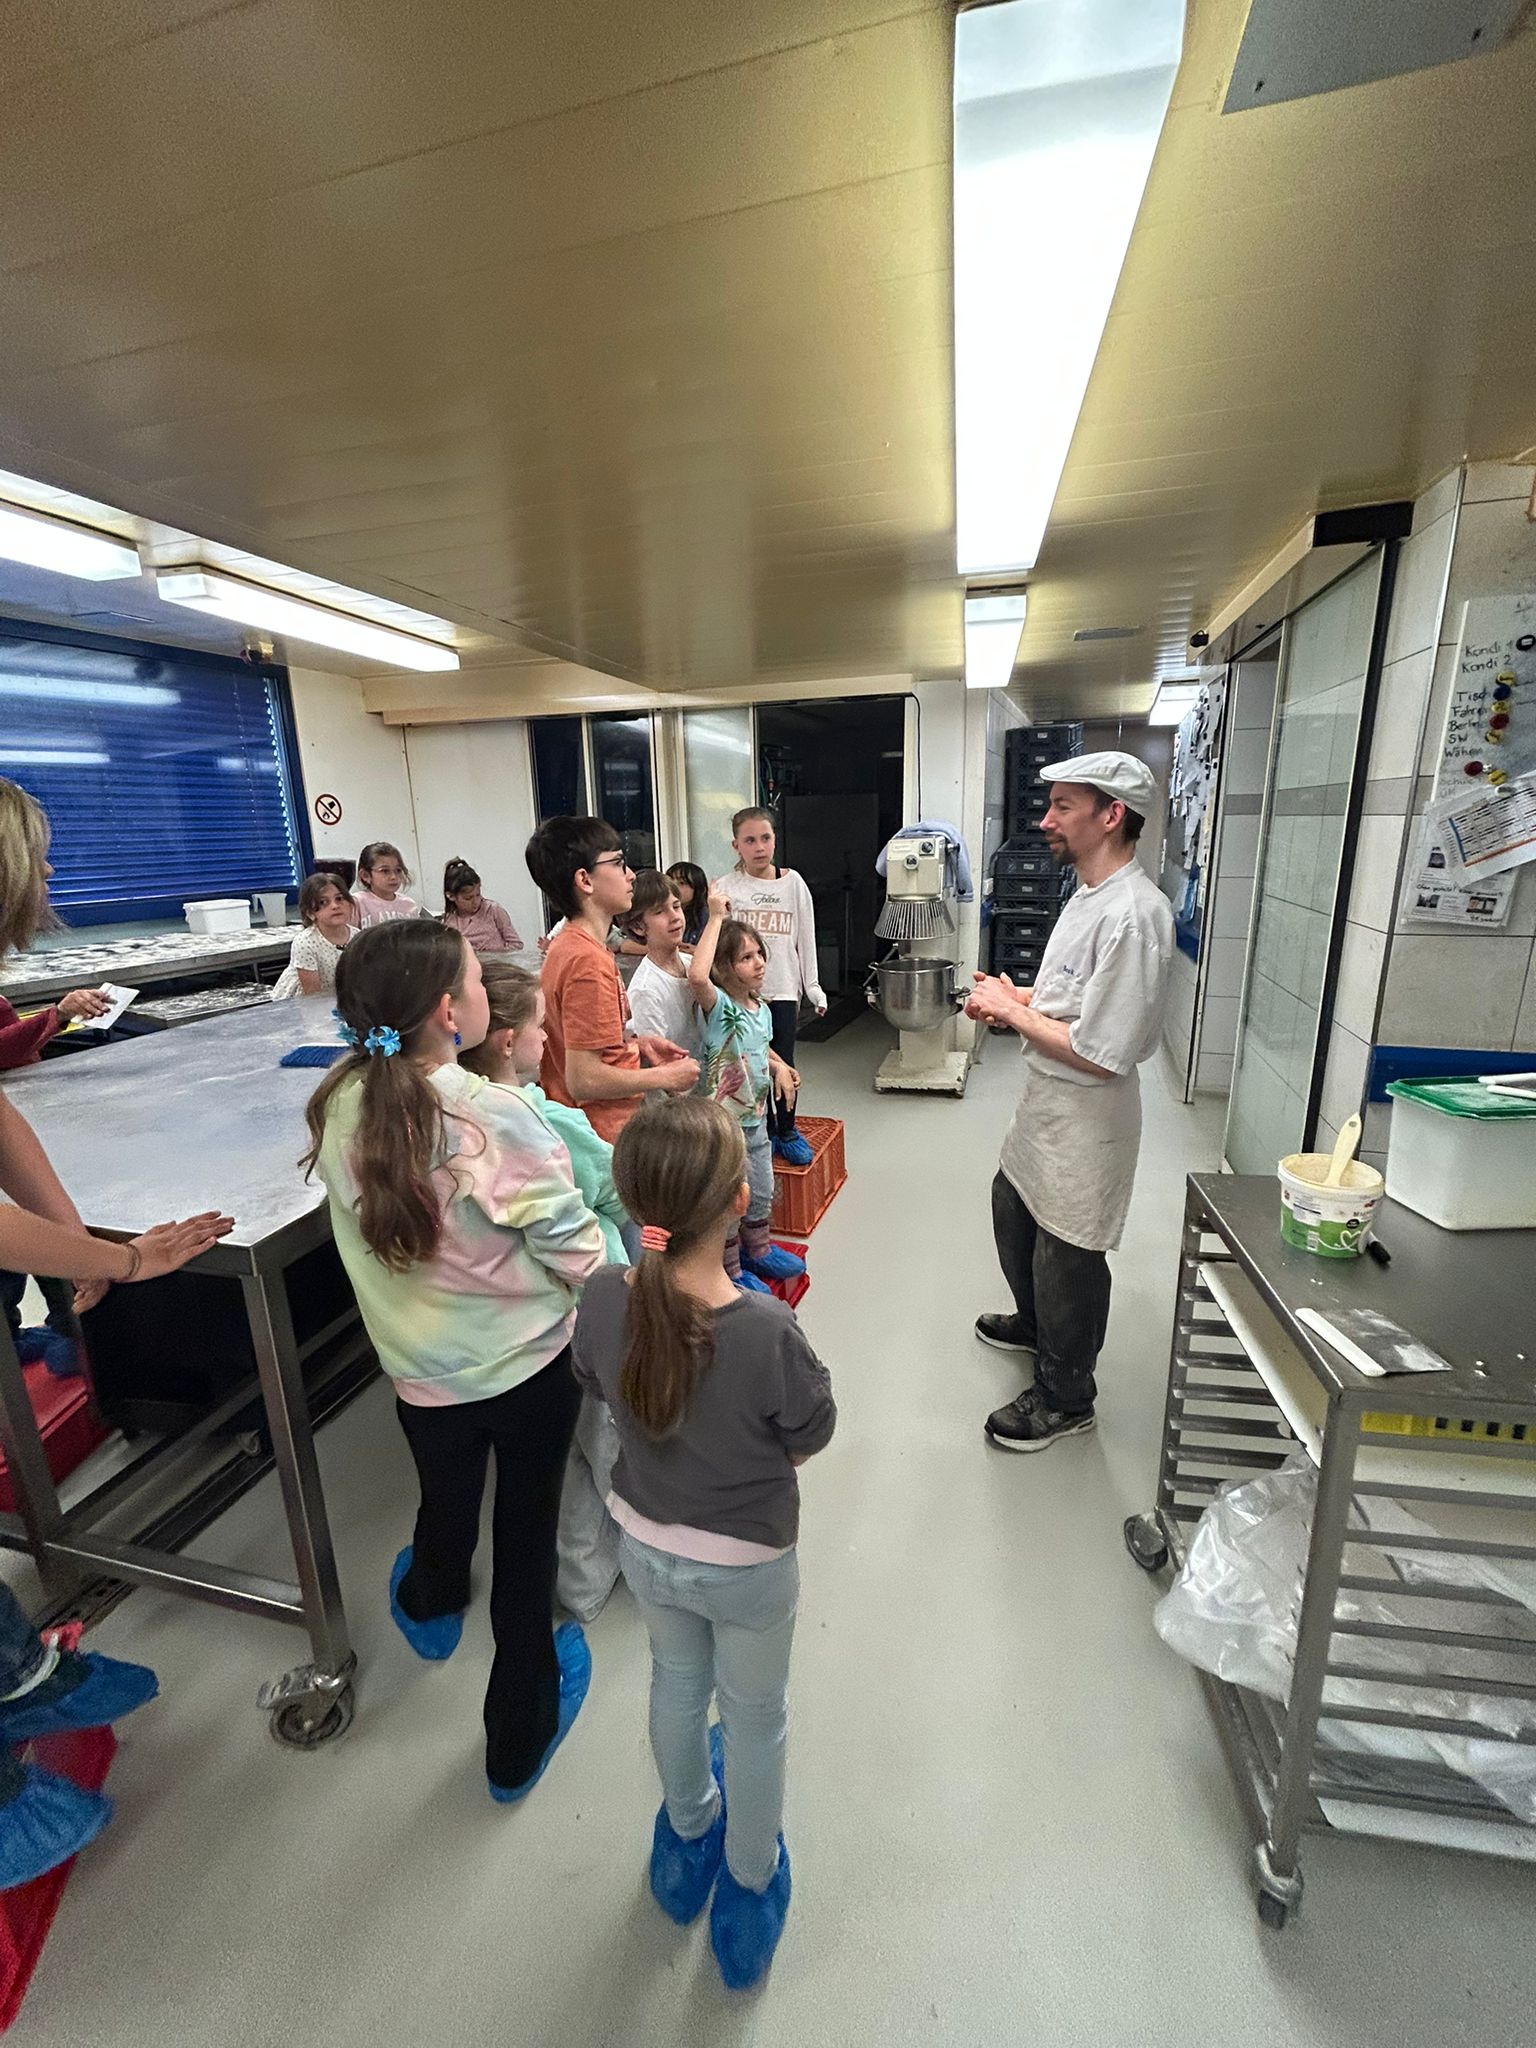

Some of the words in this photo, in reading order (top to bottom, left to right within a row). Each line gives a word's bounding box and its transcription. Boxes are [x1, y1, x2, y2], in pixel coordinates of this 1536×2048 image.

[1462, 657, 1498, 674] Kondi
[1503, 654, 1512, 666] 2
[738, 911, 791, 933] DREAM
